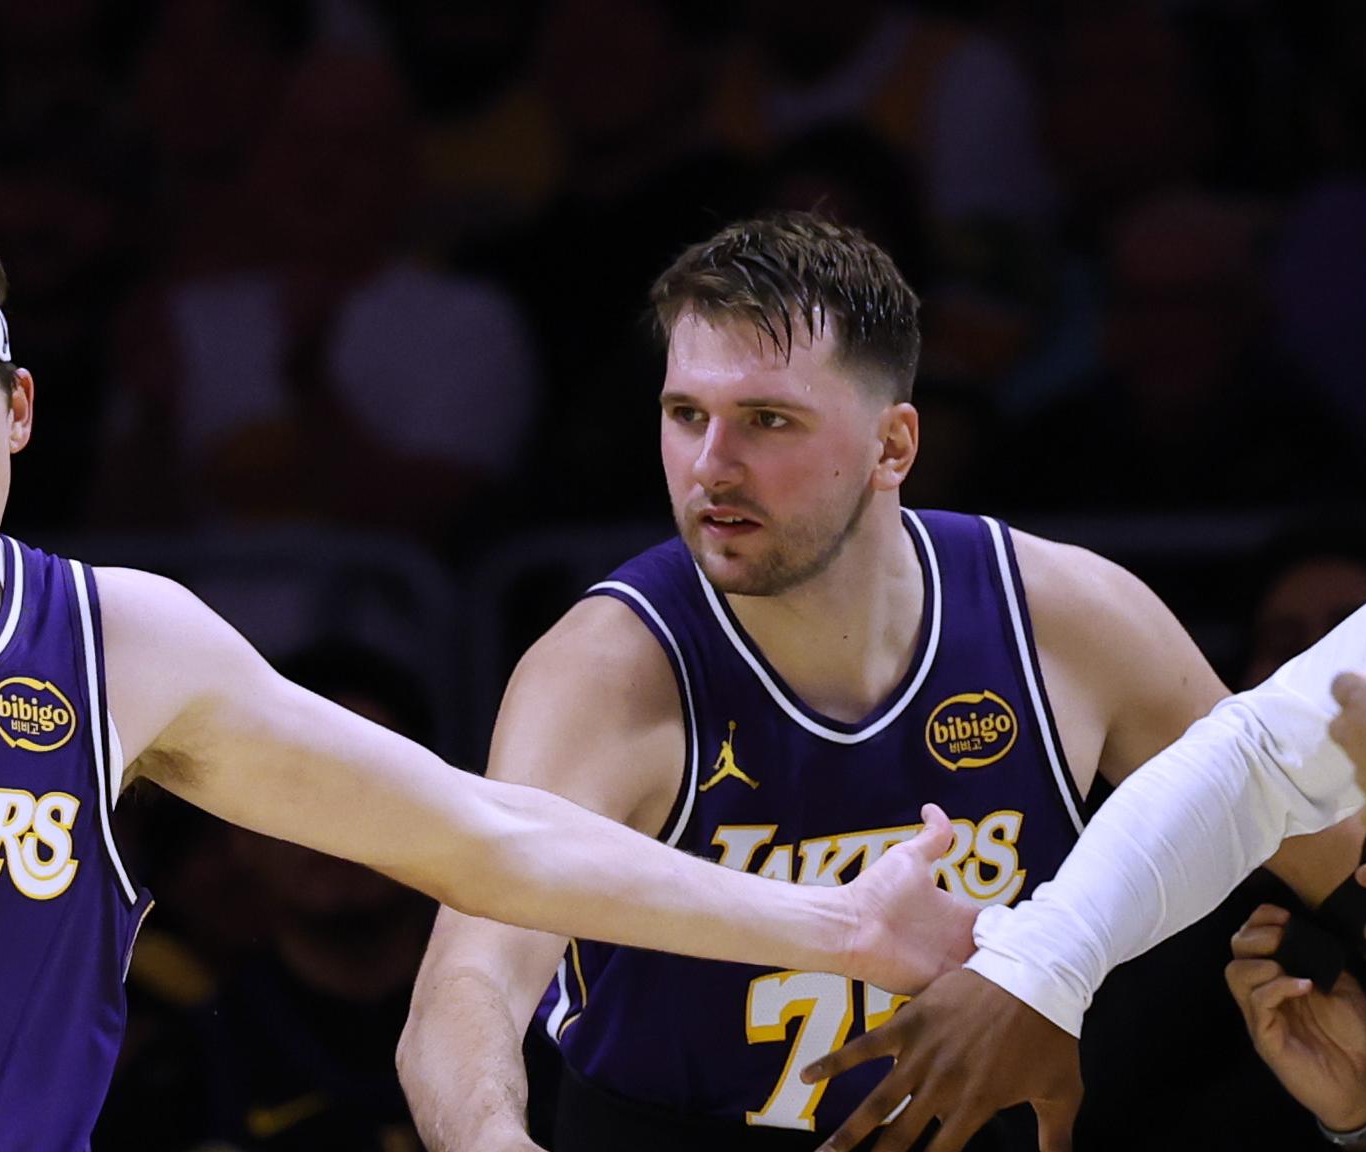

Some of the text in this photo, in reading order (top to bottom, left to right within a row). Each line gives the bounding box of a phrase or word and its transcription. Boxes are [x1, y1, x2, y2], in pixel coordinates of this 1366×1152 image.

[933, 712, 1011, 743] bibigo
[711, 810, 1028, 908] AKRS
[745, 969, 913, 1132] 7
